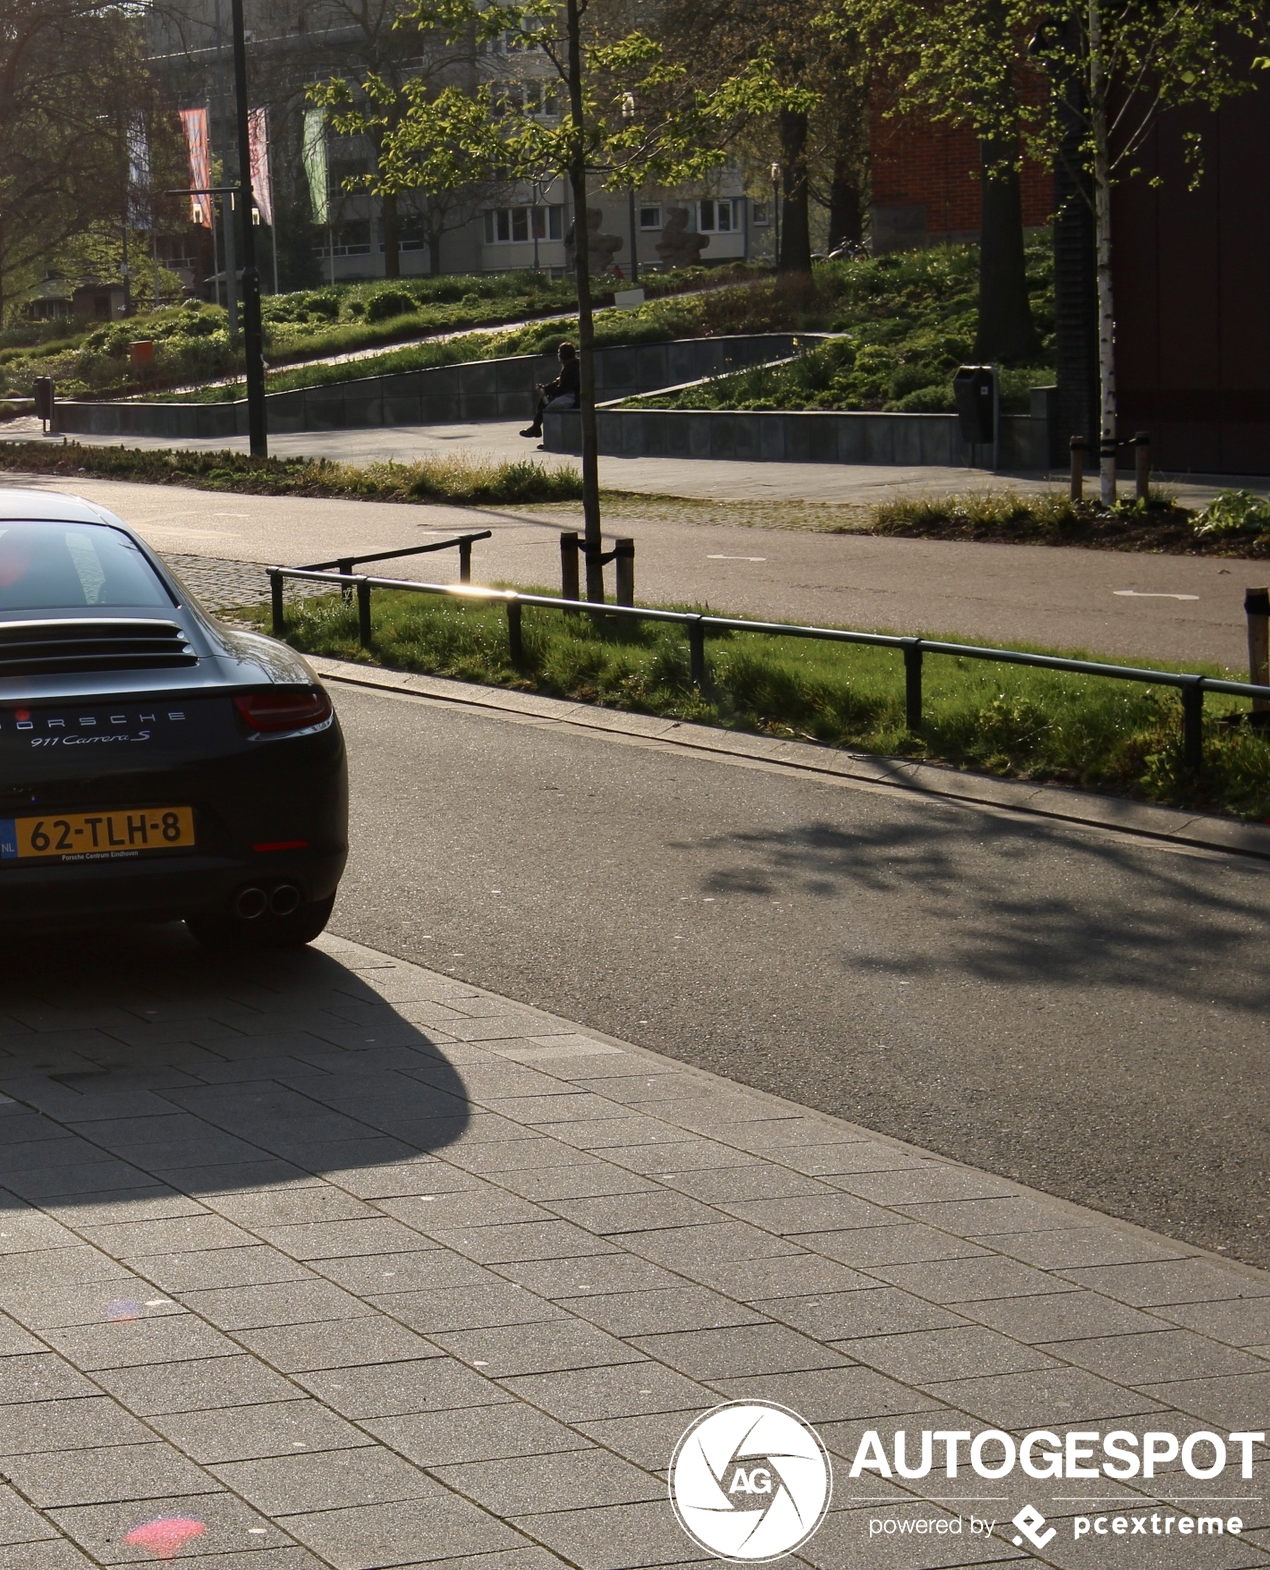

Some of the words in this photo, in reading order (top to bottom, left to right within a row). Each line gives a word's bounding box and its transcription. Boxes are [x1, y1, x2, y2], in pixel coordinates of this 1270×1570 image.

[31, 736, 60, 747] 911
[62, 734, 130, 745] Carrera
[130, 730, 150, 742] S
[1, 843, 15, 853] NL
[30, 812, 181, 851] 62-TLH-8
[110, 850, 139, 858] Eindhoven
